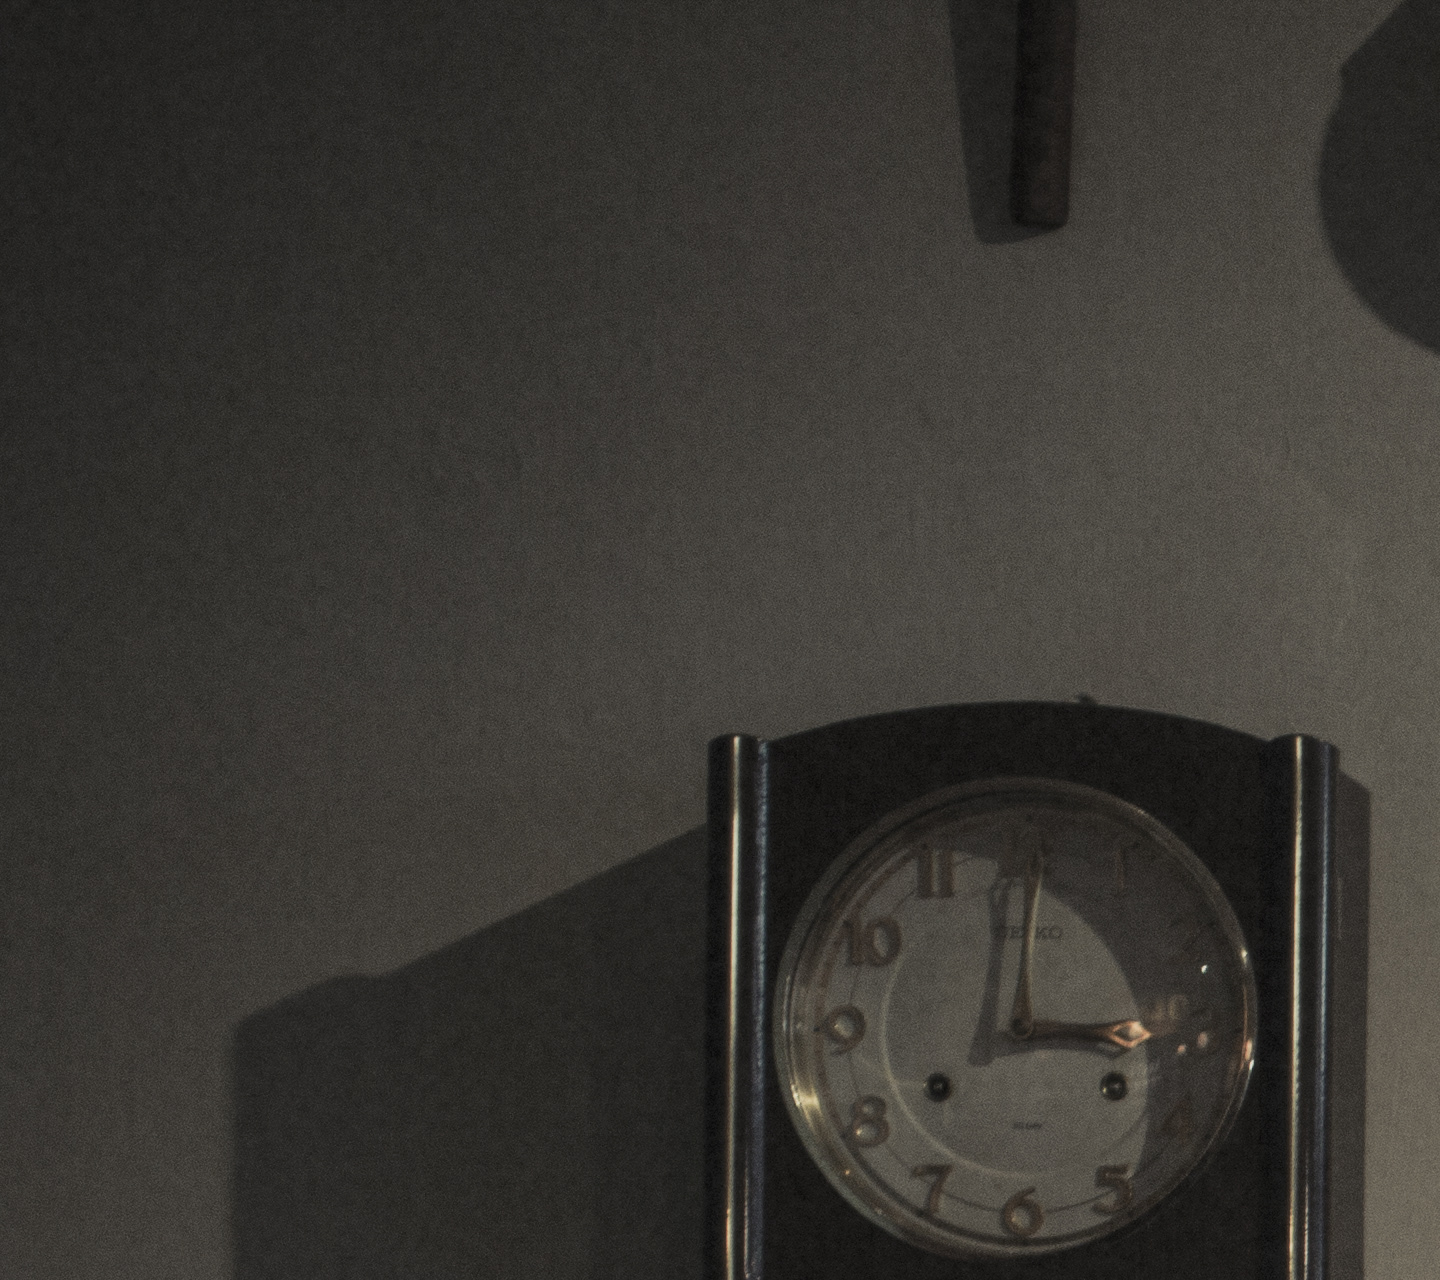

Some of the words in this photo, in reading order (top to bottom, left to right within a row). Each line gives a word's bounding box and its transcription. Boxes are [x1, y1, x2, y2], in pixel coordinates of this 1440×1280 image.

[914, 846, 957, 899] 11
[842, 913, 902, 968] 10
[995, 925, 1063, 940] SEKO
[822, 1004, 866, 1055] 9
[850, 1094, 890, 1149] 8
[910, 1165, 954, 1216] 7
[1002, 1186, 1043, 1238] 6
[1096, 1163, 1134, 1214] 5
